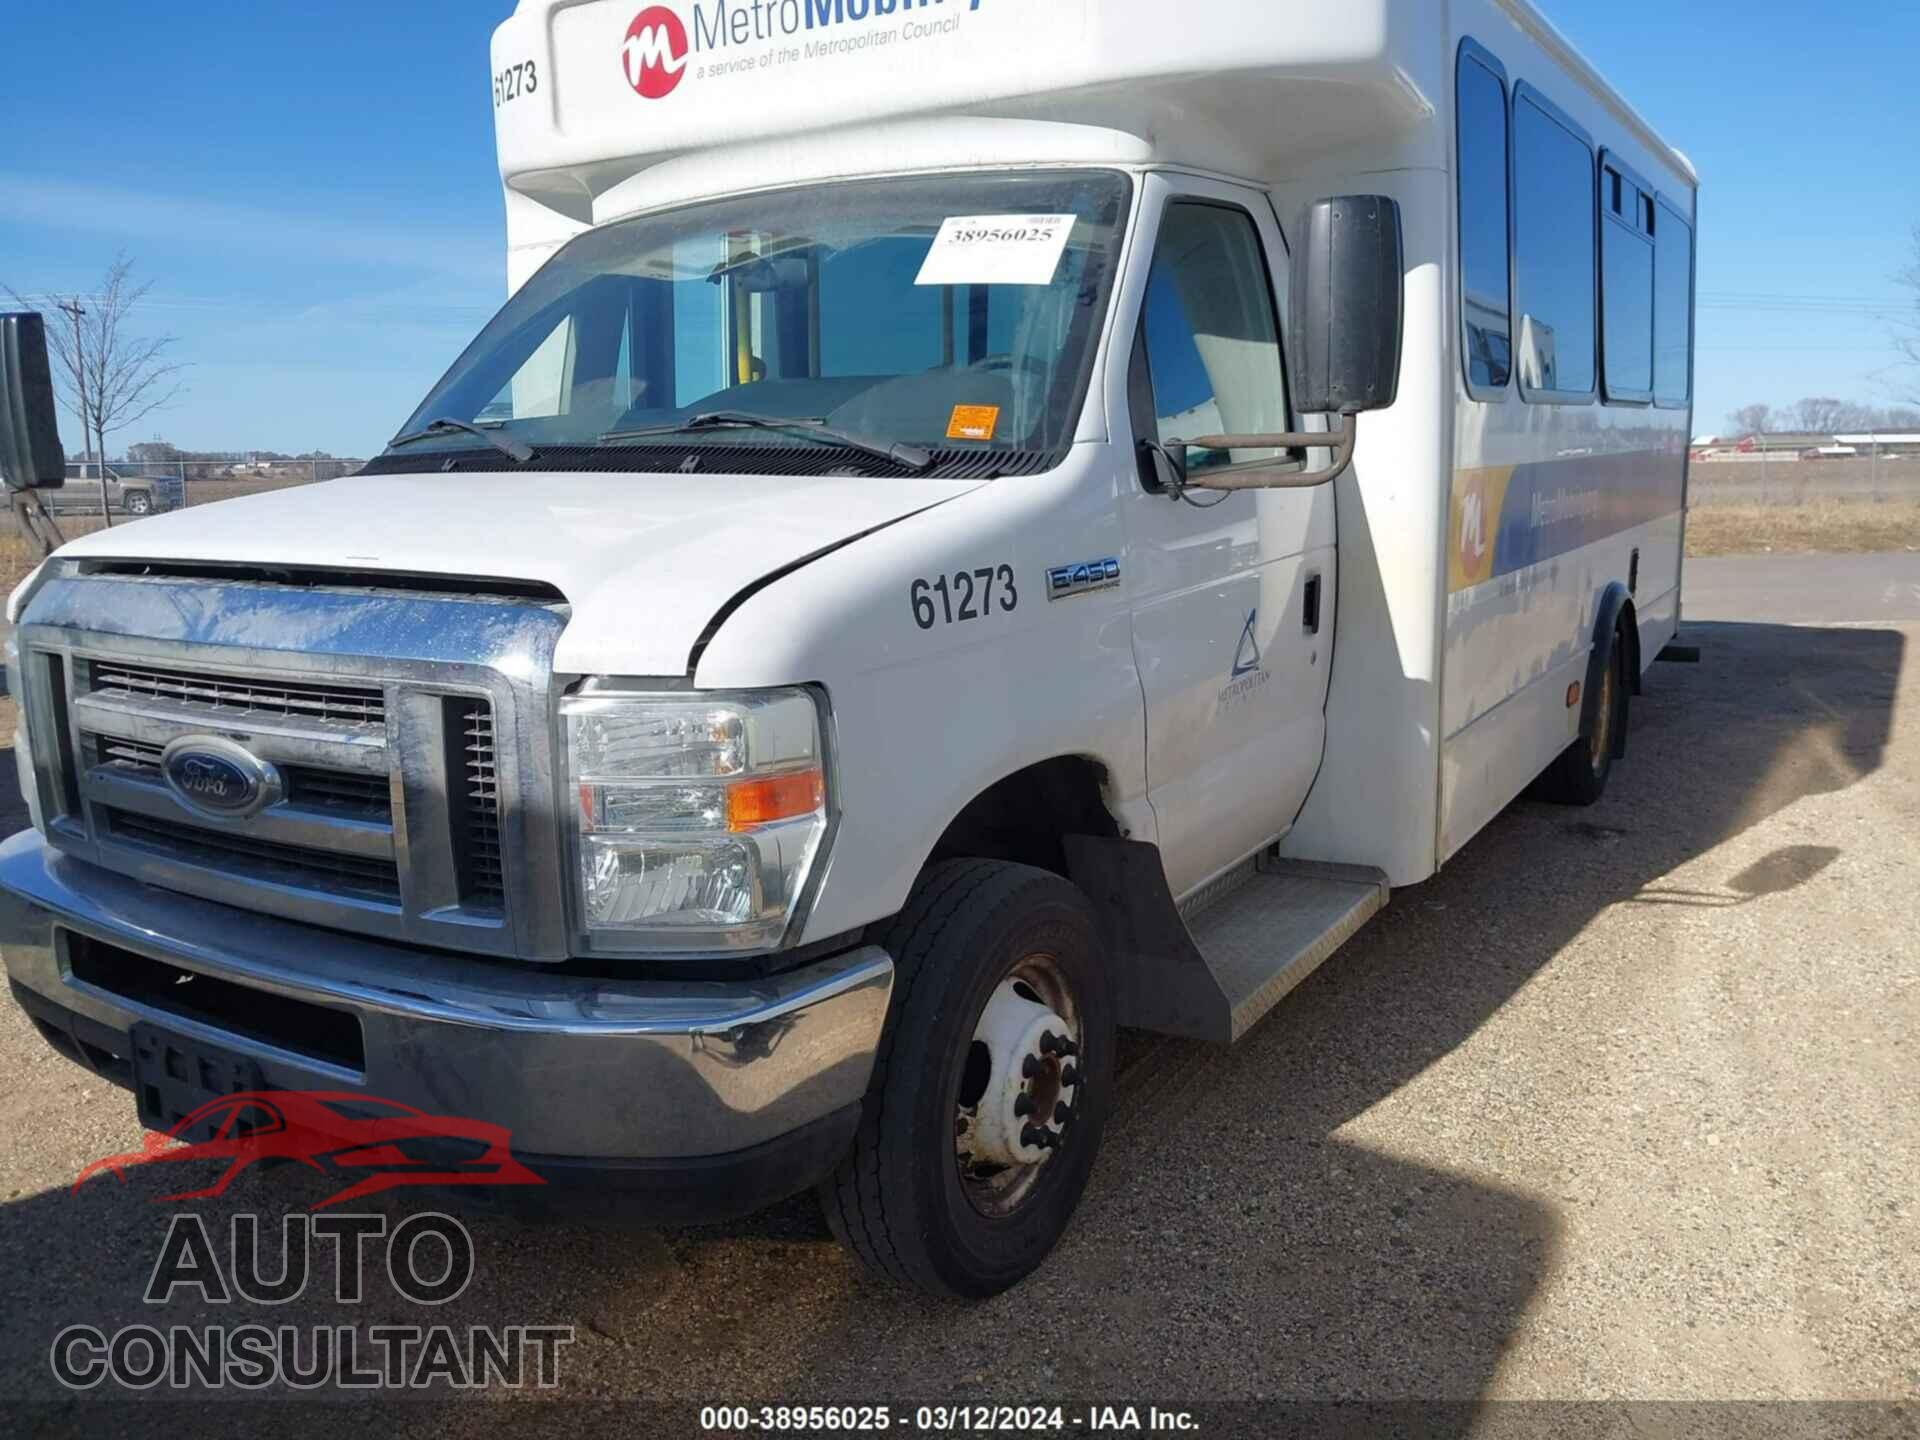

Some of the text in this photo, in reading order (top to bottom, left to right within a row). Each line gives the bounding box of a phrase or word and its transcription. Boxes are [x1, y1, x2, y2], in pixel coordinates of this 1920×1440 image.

[693, 0, 984, 52] MetroMo
[697, 13, 962, 79] a service of the Metropolitan Council
[949, 228, 1054, 243] 38956025
[911, 564, 1017, 630] 61273
[181, 759, 228, 796] Ford
